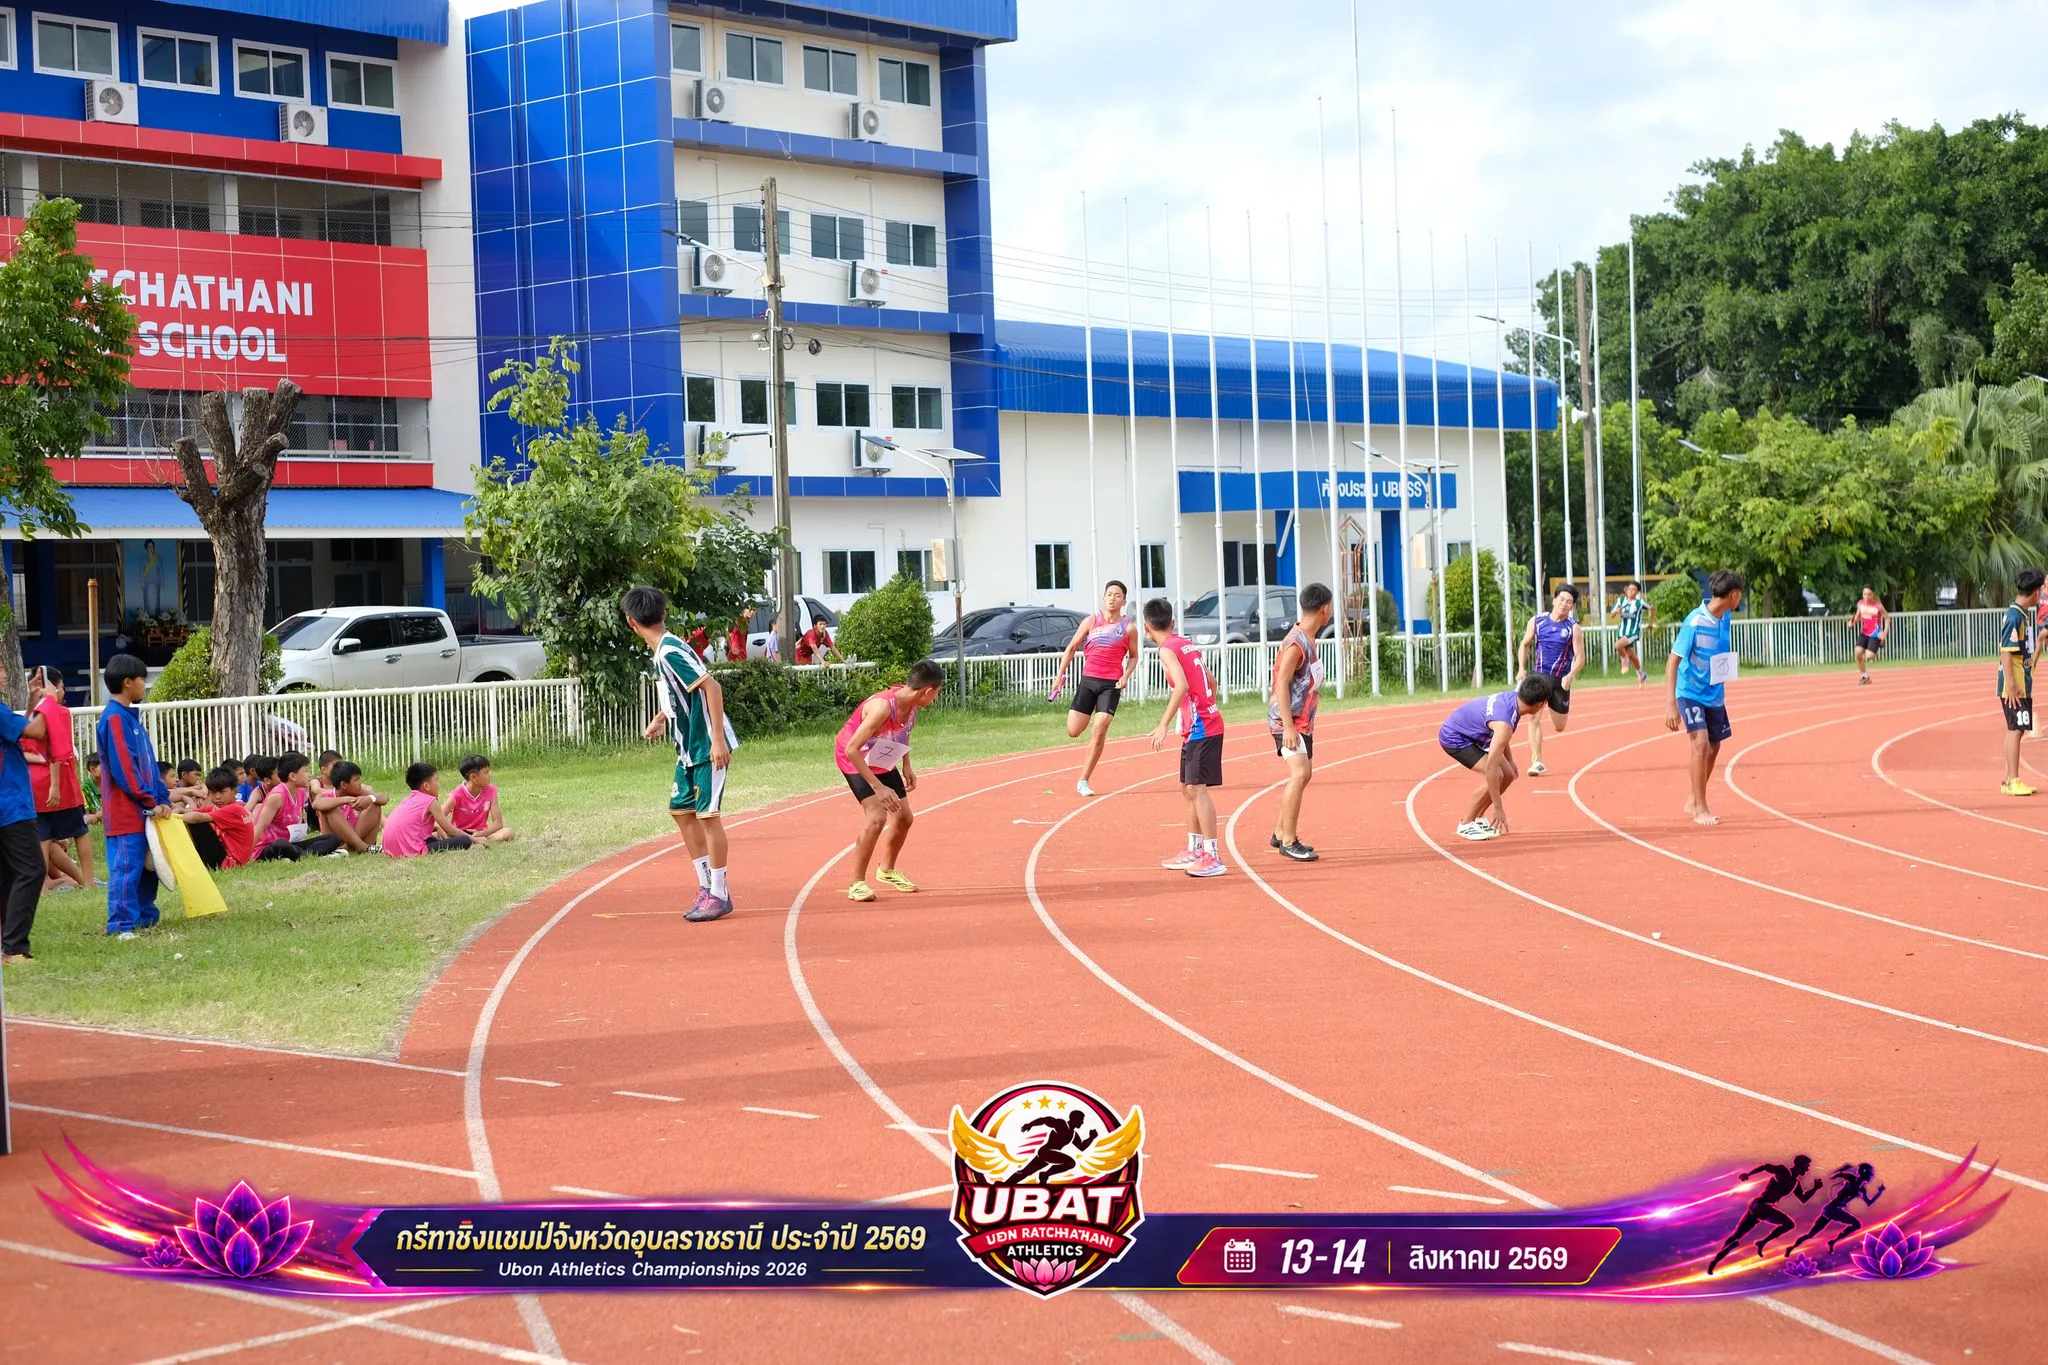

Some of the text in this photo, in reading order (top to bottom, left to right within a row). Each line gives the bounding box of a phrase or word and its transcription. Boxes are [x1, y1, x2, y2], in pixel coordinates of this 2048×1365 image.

[138, 321, 288, 363] SCHOOL
[1382, 480, 1423, 498] UBSS
[1684, 705, 1704, 725] 12
[876, 746, 894, 761] 7
